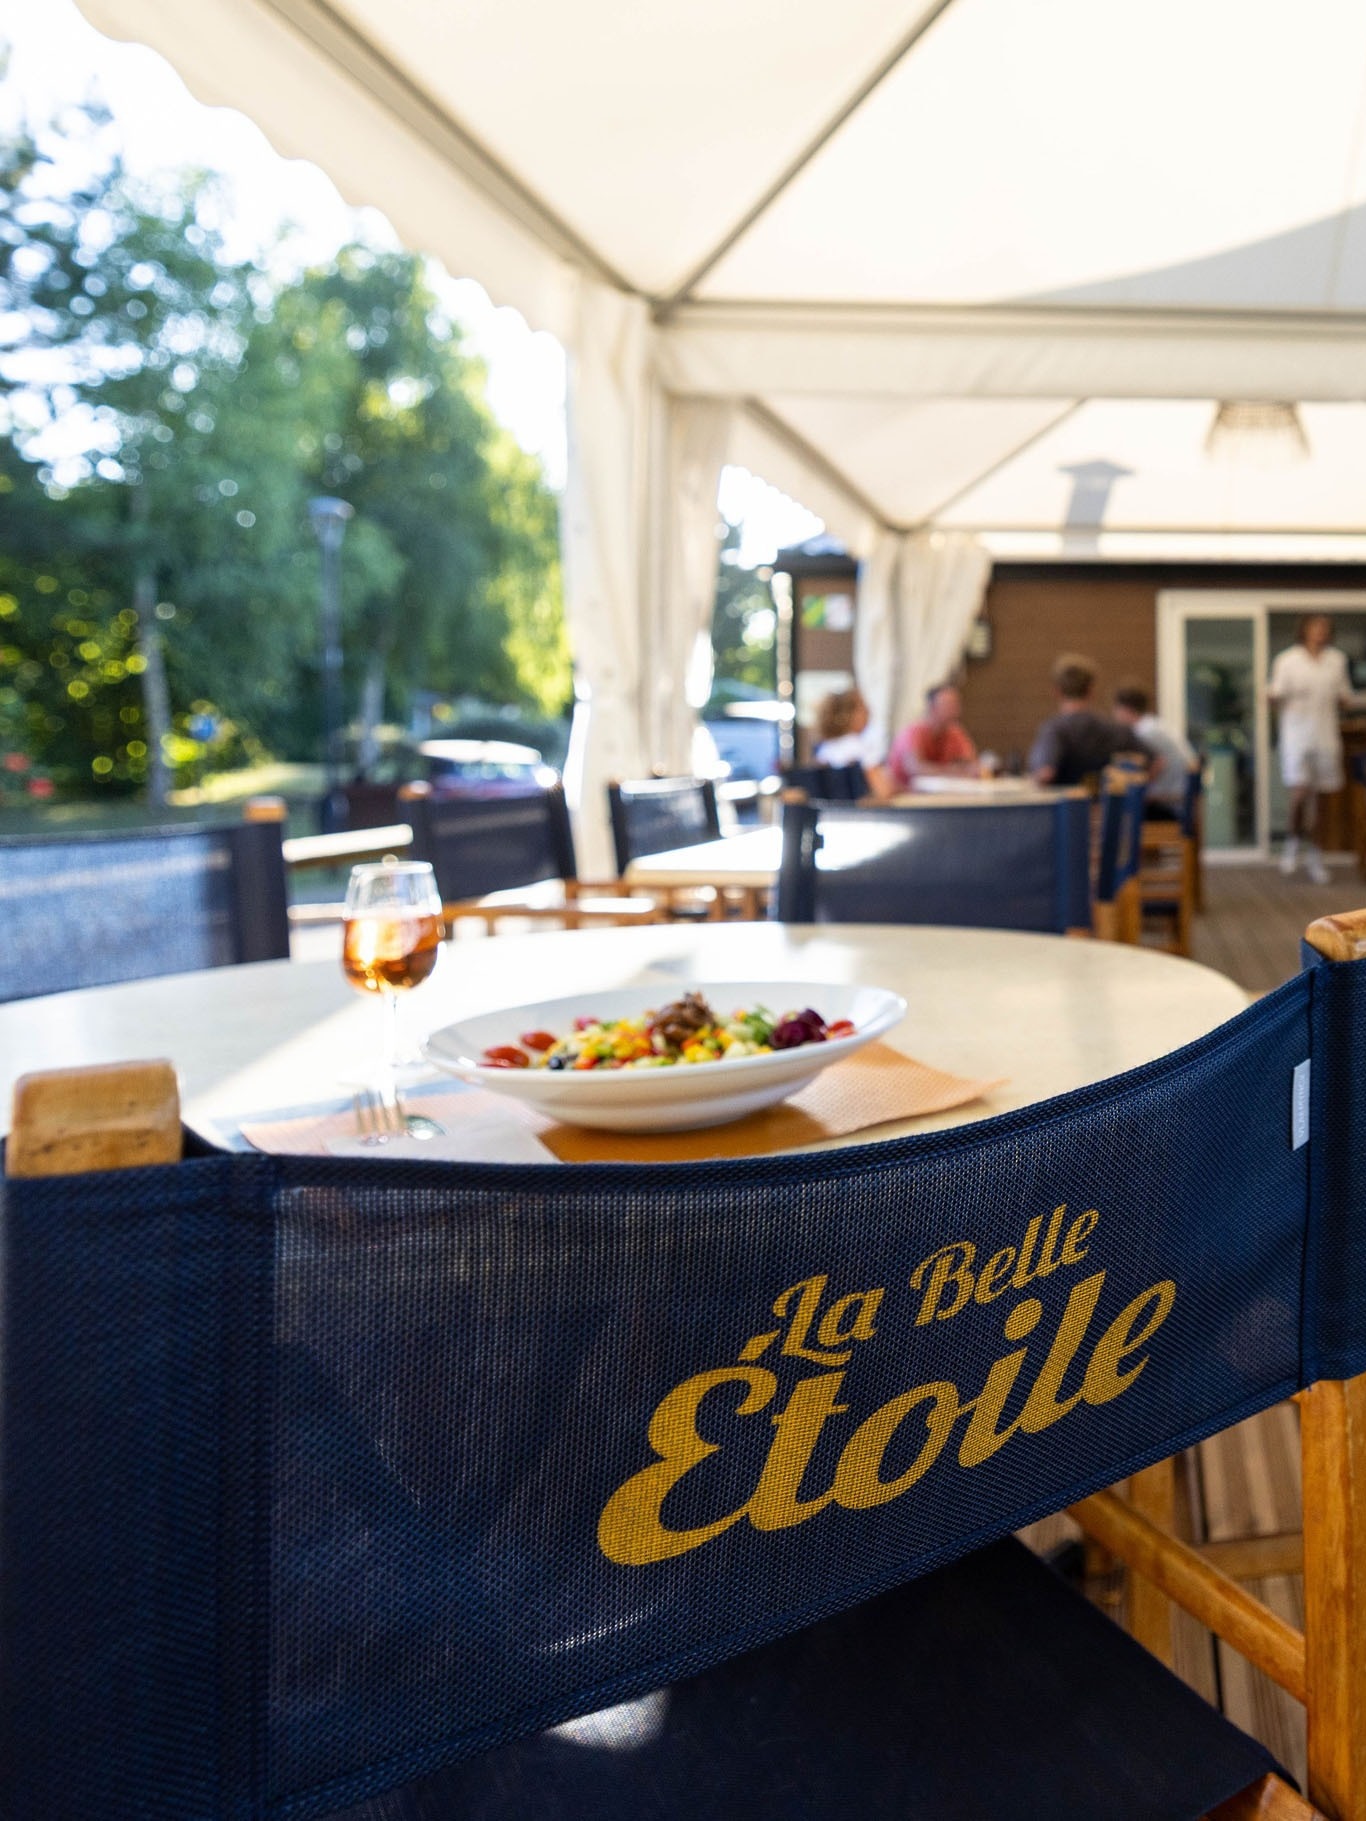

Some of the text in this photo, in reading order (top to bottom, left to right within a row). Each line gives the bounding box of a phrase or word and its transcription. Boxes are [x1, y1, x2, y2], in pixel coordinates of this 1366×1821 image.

[772, 1203, 1099, 1367] La Belle
[598, 1270, 1176, 1566] Étoile
